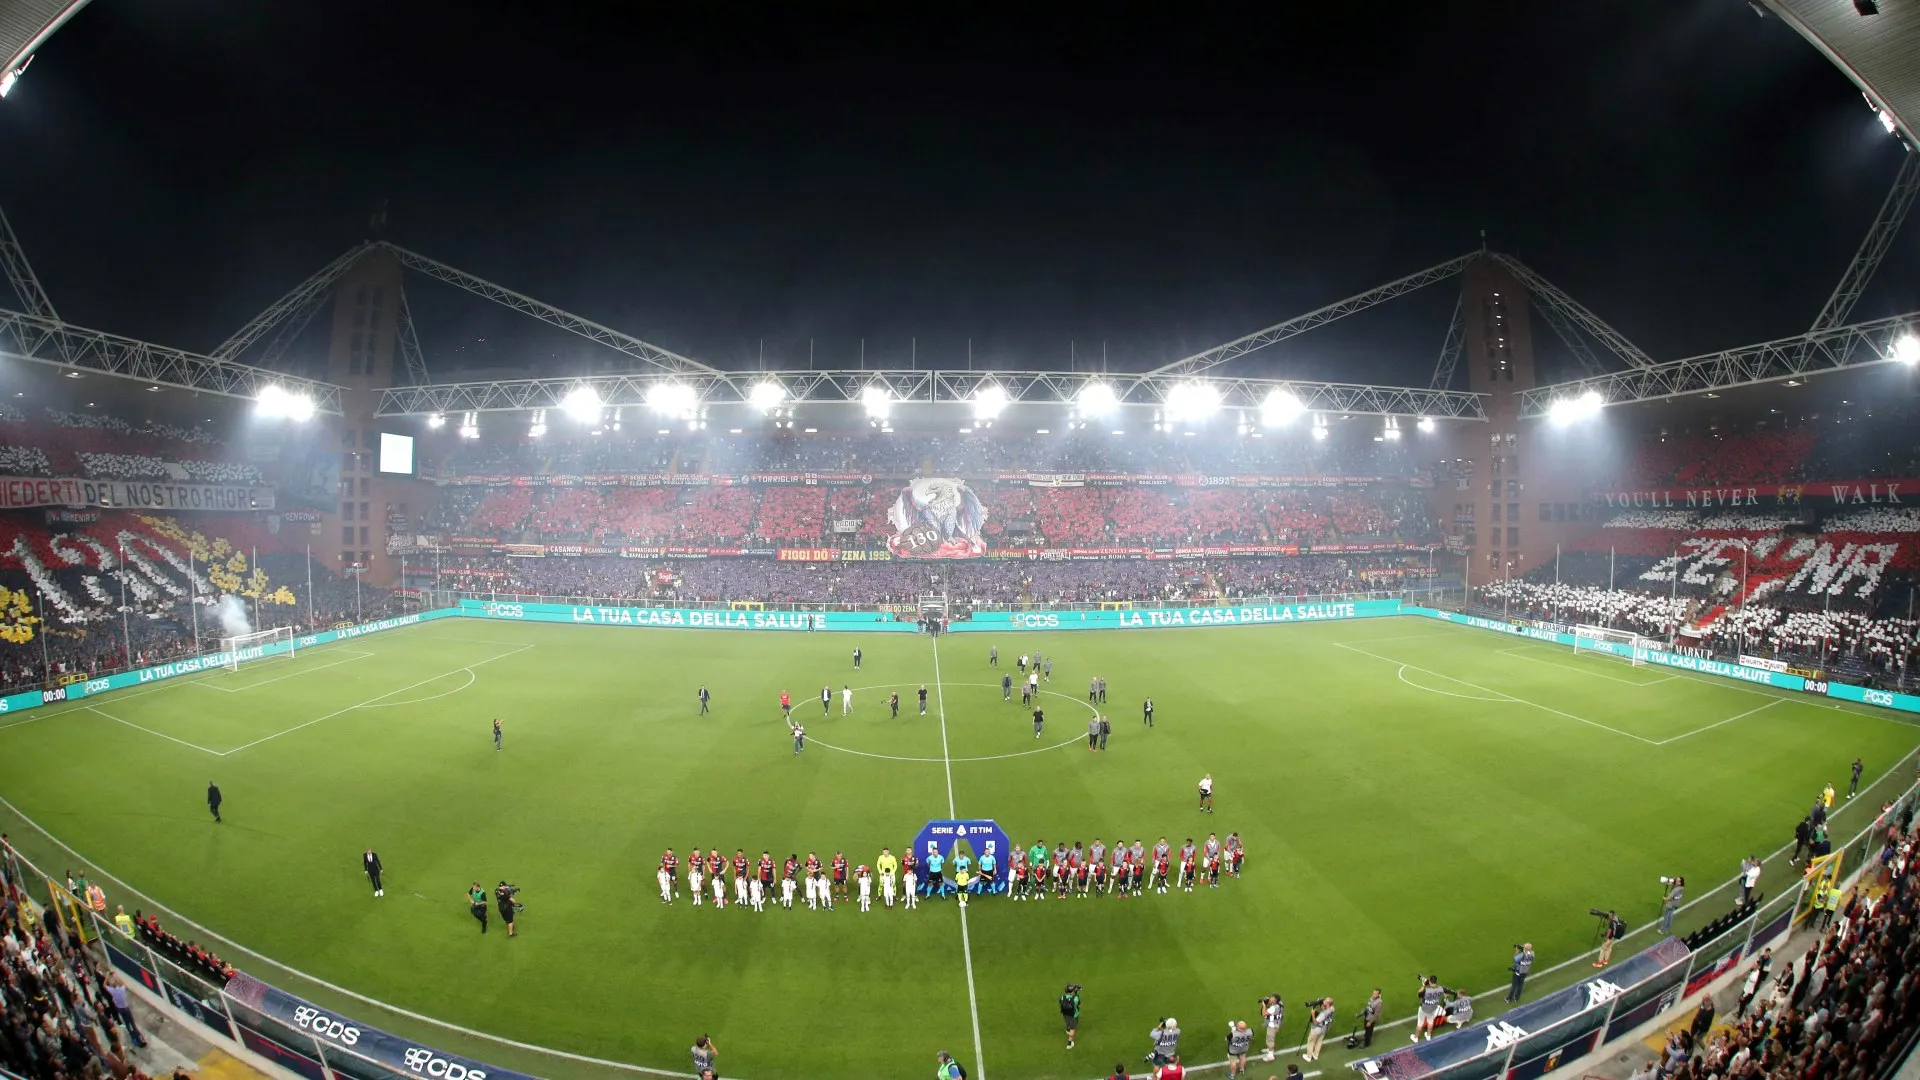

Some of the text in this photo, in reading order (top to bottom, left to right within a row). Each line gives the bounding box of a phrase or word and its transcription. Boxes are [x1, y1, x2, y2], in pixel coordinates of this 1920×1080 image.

[758, 475, 799, 484] TORRIGLIA
[0, 480, 82, 507] IEDERTI
[84, 482, 123, 508] DEL
[1605, 483, 1902, 508] YOU'LL NEVER WALK
[907, 530, 938, 549] 130
[781, 550, 811, 560] FIGGI
[841, 550, 866, 561] ZENA
[497, 604, 525, 618] CDS
[573, 607, 594, 621] LA
[597, 609, 632, 623] TUA
[636, 610, 685, 625] CASA
[689, 611, 748, 628] DELLA
[901, 605, 916, 613] ZENA
[1119, 603, 1355, 626] LA TUA CASA DELLA SALUTE
[337, 614, 420, 639] LA TUA CASA DELLA SALUTE
[1025, 614, 1059, 628] CDS
[1476, 618, 1488, 627] TUA
[1489, 621, 1506, 632] CASA
[1530, 629, 1558, 641] SALUTE
[1674, 644, 1713, 660] MARKUP
[140, 669, 154, 682] LA
[155, 665, 174, 679] TUA
[176, 660, 201, 675] CASA
[203, 653, 232, 668] DELLA
[1637, 649, 1771, 684] LA TUA CASA DELLA SALUTE
[92, 678, 110, 693] CDS
[1804, 679, 1828, 693] 00:00
[43, 688, 66, 703] 00:00
[1871, 691, 1893, 706] CDS
[312, 1016, 360, 1046] CDS
